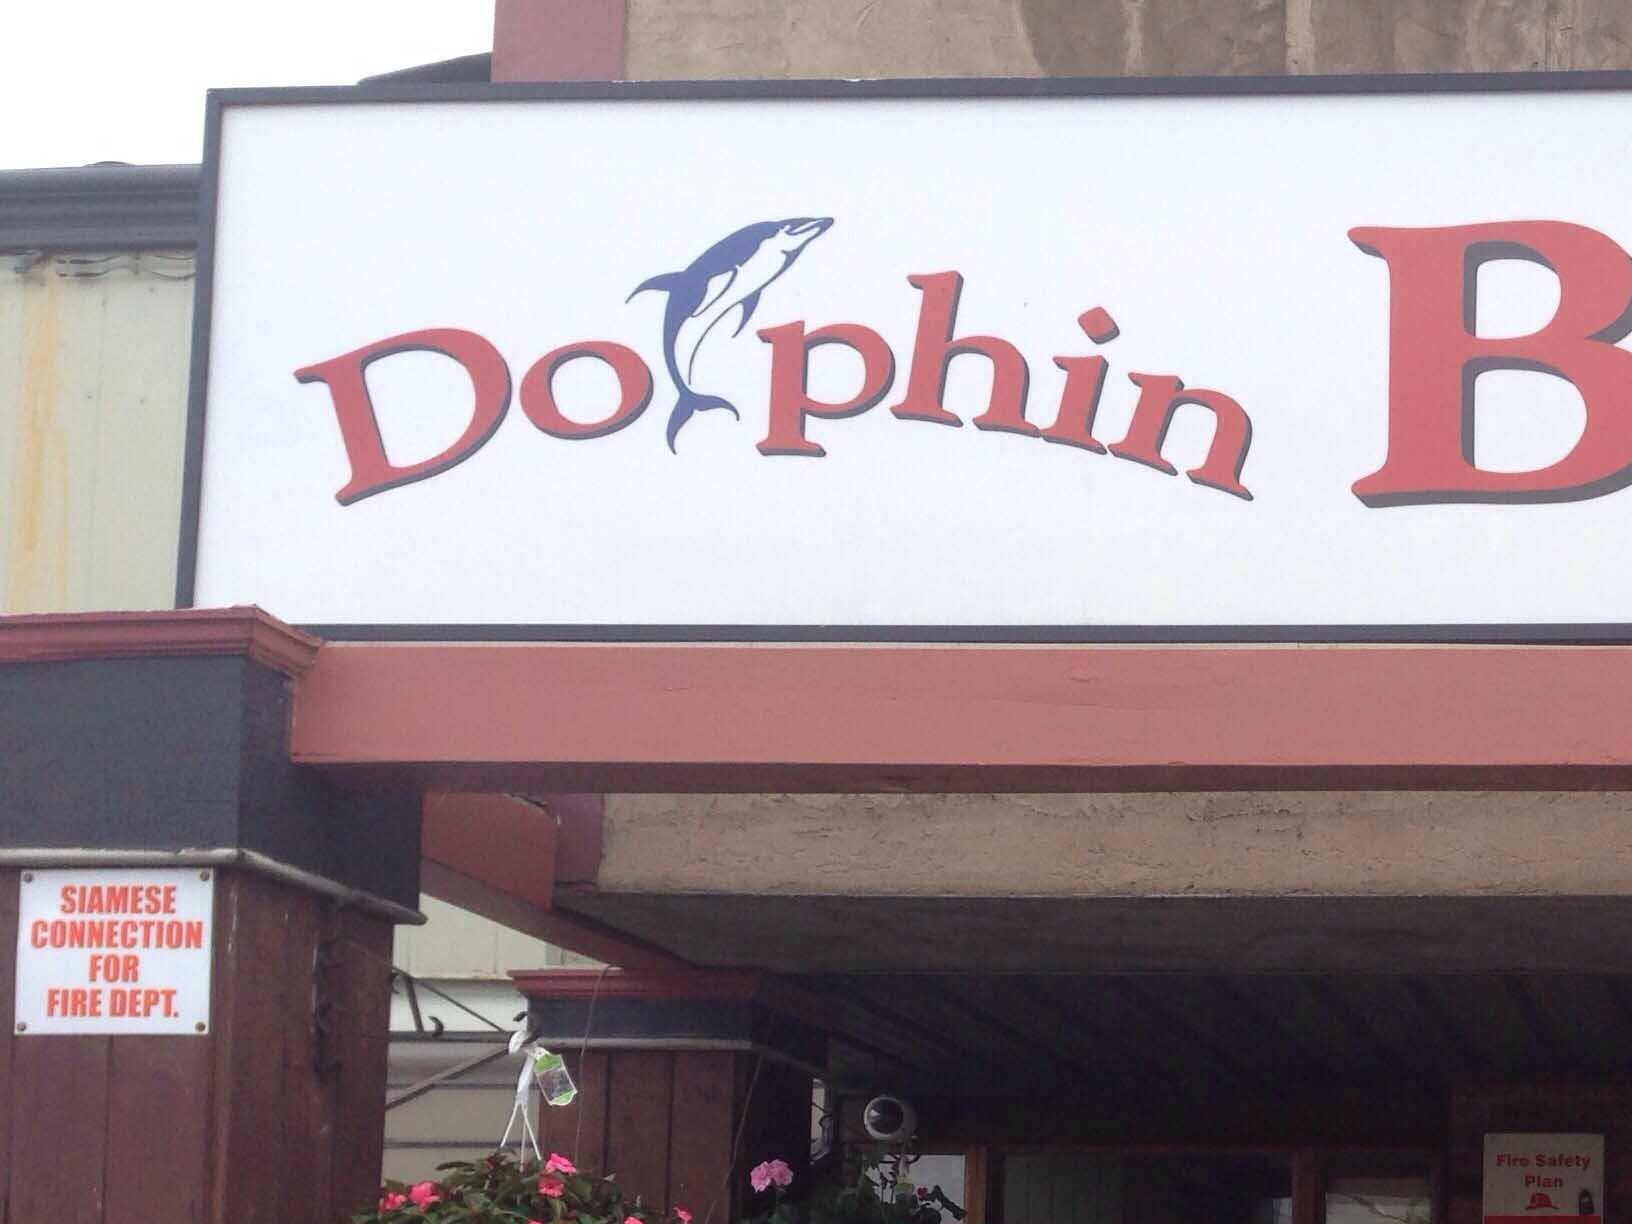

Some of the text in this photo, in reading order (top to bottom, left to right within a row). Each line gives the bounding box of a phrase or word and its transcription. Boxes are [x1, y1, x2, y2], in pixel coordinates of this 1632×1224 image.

[60, 885, 177, 914] SIAMESE
[31, 919, 203, 949] CONNECTION
[89, 954, 140, 982] FOR
[46, 988, 179, 1017] FIRE DEPT.
[1496, 1154, 1591, 1170] Fire Safety
[1524, 1175, 1563, 1188] Plan
